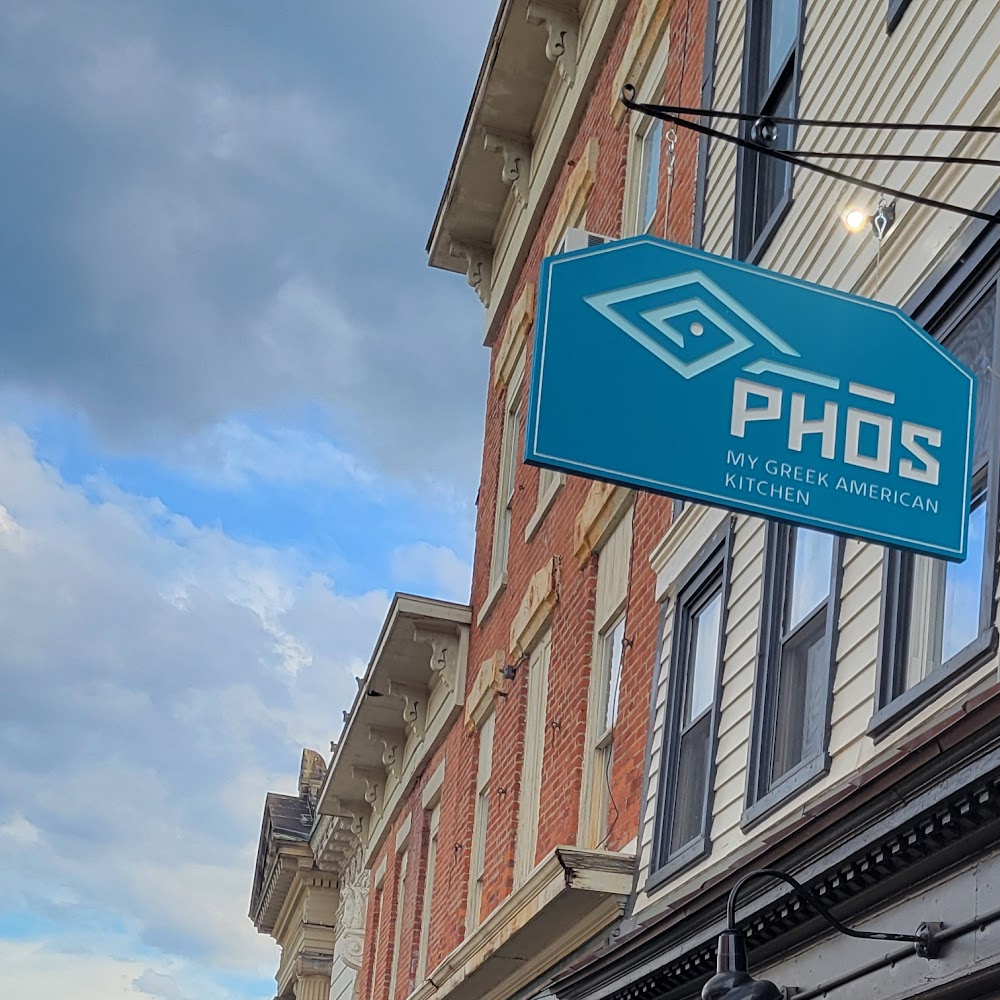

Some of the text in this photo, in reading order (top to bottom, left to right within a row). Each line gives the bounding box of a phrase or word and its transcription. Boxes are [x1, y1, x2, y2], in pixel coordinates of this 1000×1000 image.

[725, 472, 810, 506] KITCHEN
[726, 450, 939, 514] MY GREEK AMERICAN
